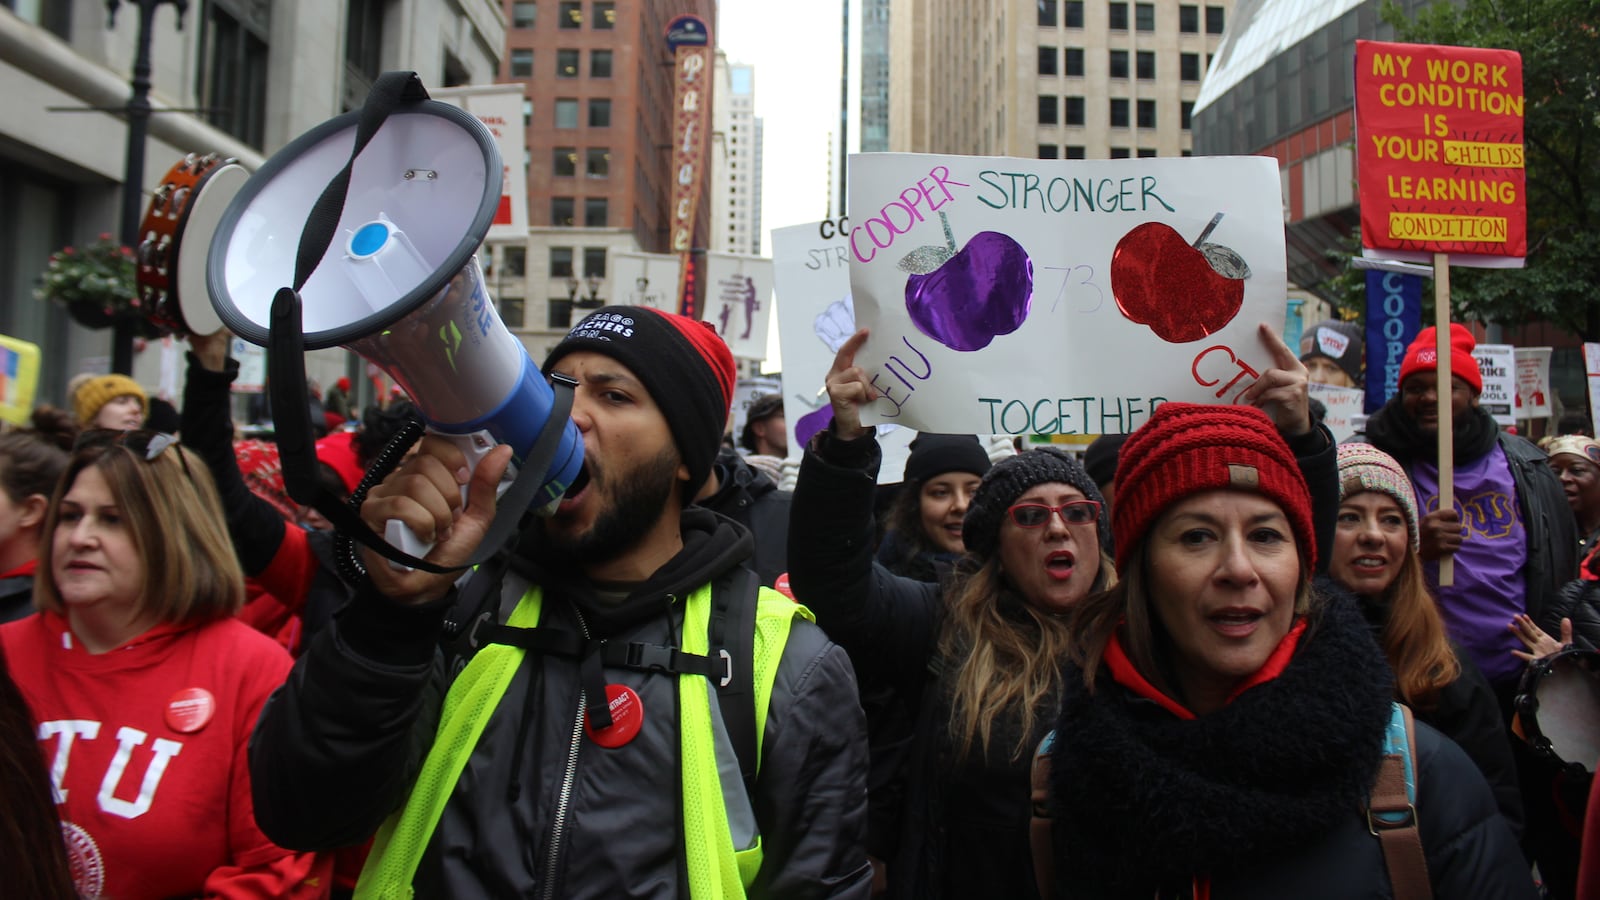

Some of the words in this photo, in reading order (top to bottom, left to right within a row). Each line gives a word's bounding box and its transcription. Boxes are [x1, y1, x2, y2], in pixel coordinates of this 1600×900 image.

[1372, 53, 1412, 78] MY
[1426, 59, 1508, 88] WORK
[1379, 82, 1523, 117] CONDITION
[1424, 113, 1449, 137] IS
[673, 54, 704, 250] Palace
[1372, 135, 1439, 162] YOUR
[977, 170, 1175, 213] STRONGER
[1387, 175, 1516, 204] LEARNING
[820, 216, 849, 239] CO
[851, 166, 970, 264] COOPER
[1390, 216, 1505, 239] CONDITION
[805, 246, 849, 270] STR
[1044, 264, 1103, 313] 73
[876, 335, 932, 418] SEIU
[1480, 367, 1506, 377] RIKE
[1481, 392, 1508, 400] OOLS
[37, 719, 183, 820] TU
